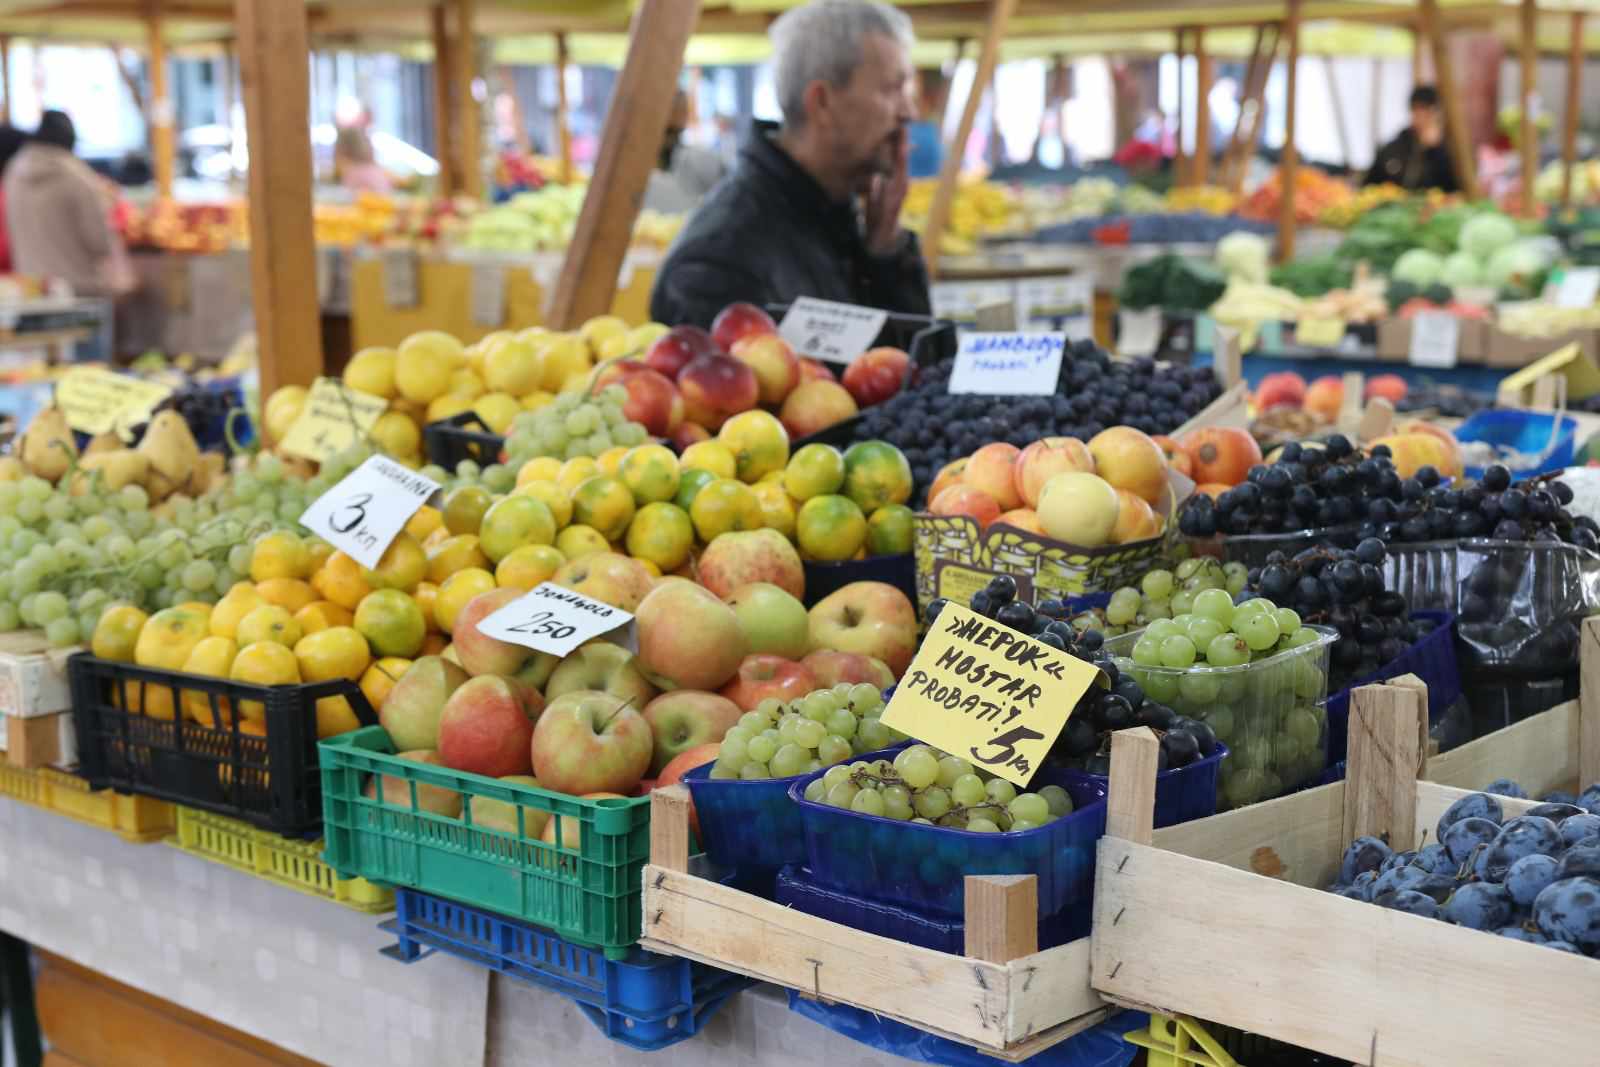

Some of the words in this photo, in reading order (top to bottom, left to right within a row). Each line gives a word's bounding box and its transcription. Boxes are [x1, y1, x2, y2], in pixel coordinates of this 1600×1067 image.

[328, 493, 374, 533] 3
[935, 645, 1042, 709] MOSTAR
[970, 725, 1045, 764] 5
